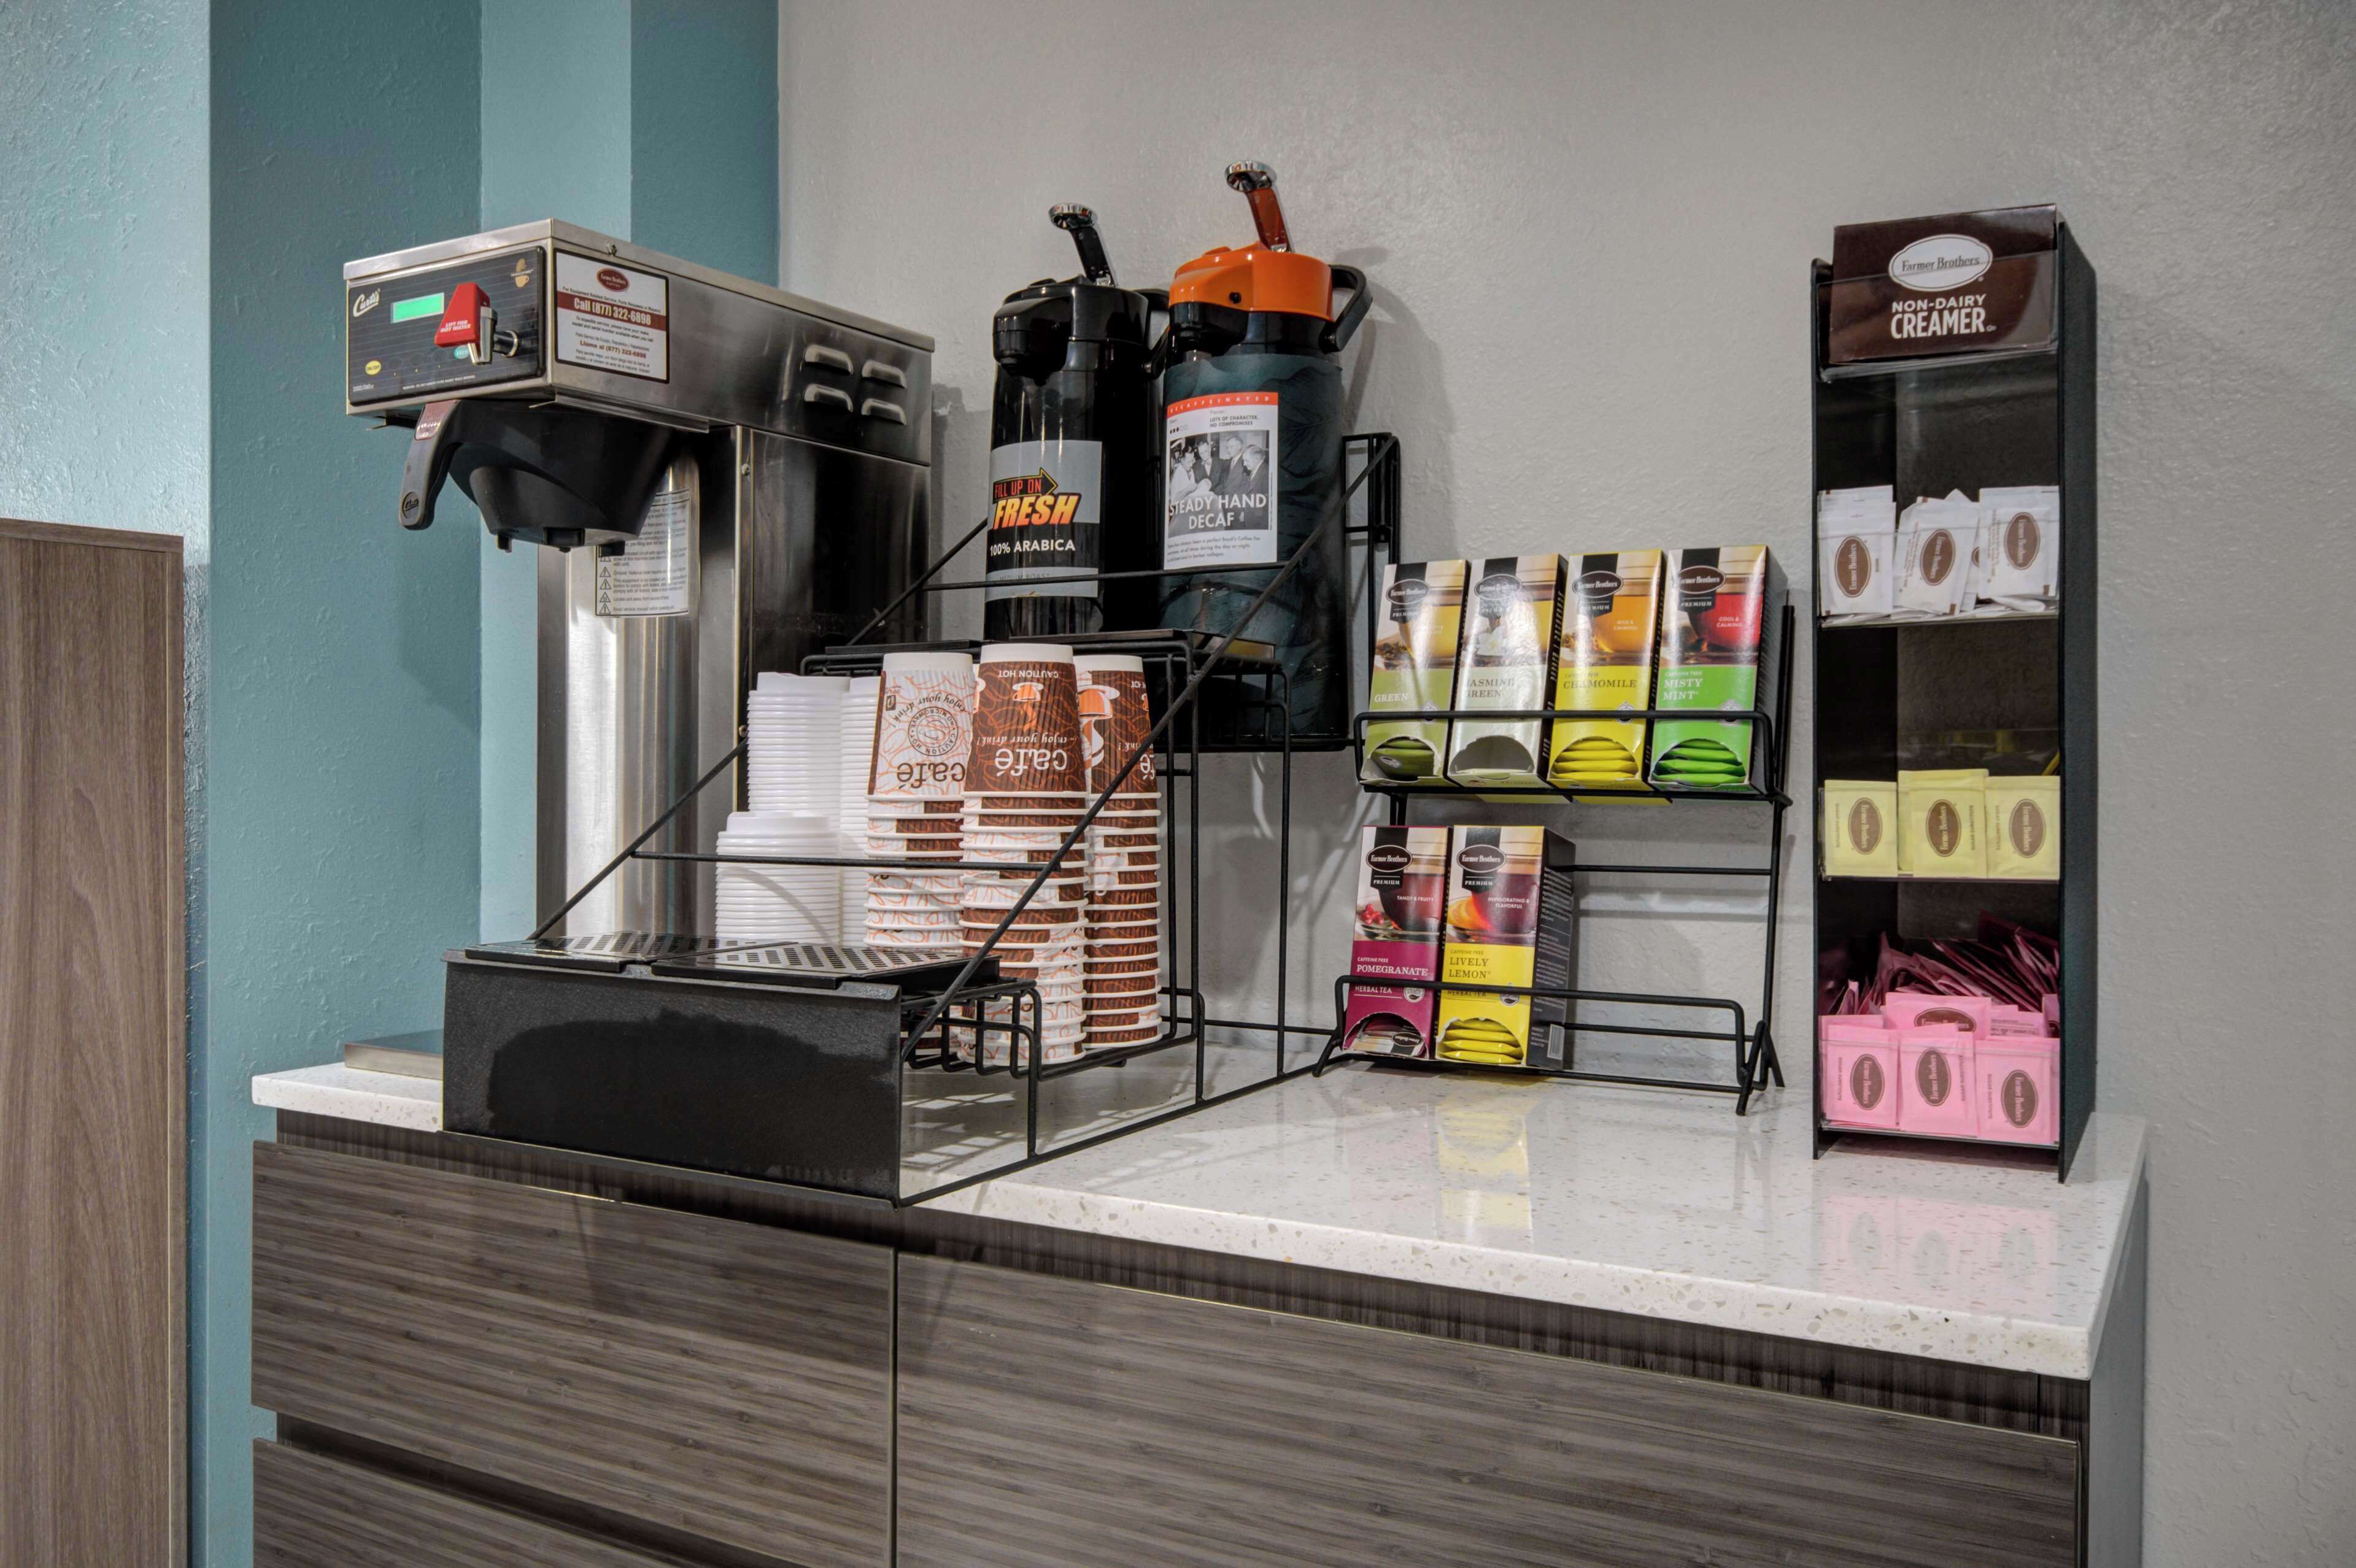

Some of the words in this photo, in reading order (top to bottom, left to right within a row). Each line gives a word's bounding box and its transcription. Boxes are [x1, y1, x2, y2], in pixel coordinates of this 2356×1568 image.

[1902, 260, 1934, 271] Farmer
[1937, 255, 1980, 269] Brothers
[353, 292, 379, 317] Curtis
[574, 297, 590, 312] Call
[592, 302, 611, 317] (877)
[613, 307, 652, 325] 322-6898
[1892, 294, 1987, 313] NON-DAIRY
[1891, 307, 1985, 339] CREAMER
[606, 346, 620, 354] (877)
[1170, 396, 1270, 413] DECAFFEINATED
[995, 483, 1007, 498] FILL
[1011, 480, 1023, 495] UP
[1028, 479, 1041, 493] ON
[993, 494, 1079, 530] FRESH
[1170, 496, 1213, 516] STEADY
[1218, 493, 1267, 509] HAND
[1189, 512, 1235, 530] DECAF
[990, 542, 1010, 557] 100%
[1013, 539, 1075, 552] ARABICA
[1848, 543, 1858, 569] Brothers
[1596, 580, 1618, 589] Brothers
[1696, 575, 1720, 584] Brothers
[1849, 570, 1858, 590] Farmer
[1564, 679, 1637, 689] CHAMOMILE
[1664, 678, 1703, 688] MISTY
[918, 692, 941, 705] your
[943, 693, 965, 712] enjoy
[1375, 693, 1409, 703] GREEN
[911, 708, 946, 728] MICROWAVE
[947, 716, 955, 727] NO
[910, 734, 922, 749] HOT
[925, 733, 956, 754] CAUTION
[1011, 732, 1038, 743] your
[1041, 732, 1067, 745] enjoy
[995, 748, 1067, 777] café
[897, 762, 965, 789] café
[1939, 805, 1947, 828] Brothers
[2022, 806, 2031, 827] Farmer
[1939, 829, 1948, 851] Farmer
[2023, 827, 2033, 853] Brothers
[1371, 854, 1386, 863] Farmer
[1387, 854, 1408, 863] Brothers
[1356, 965, 1428, 976] POMEGRANATE
[1450, 957, 1489, 967] LIVELY
[1863, 1060, 1872, 1083] Farmer
[1862, 1083, 1872, 1104] Brothers
[1929, 1078, 1939, 1100] Farmer
[2015, 1076, 2023, 1097] Farmer
[2014, 1097, 2023, 1122] Brothers
